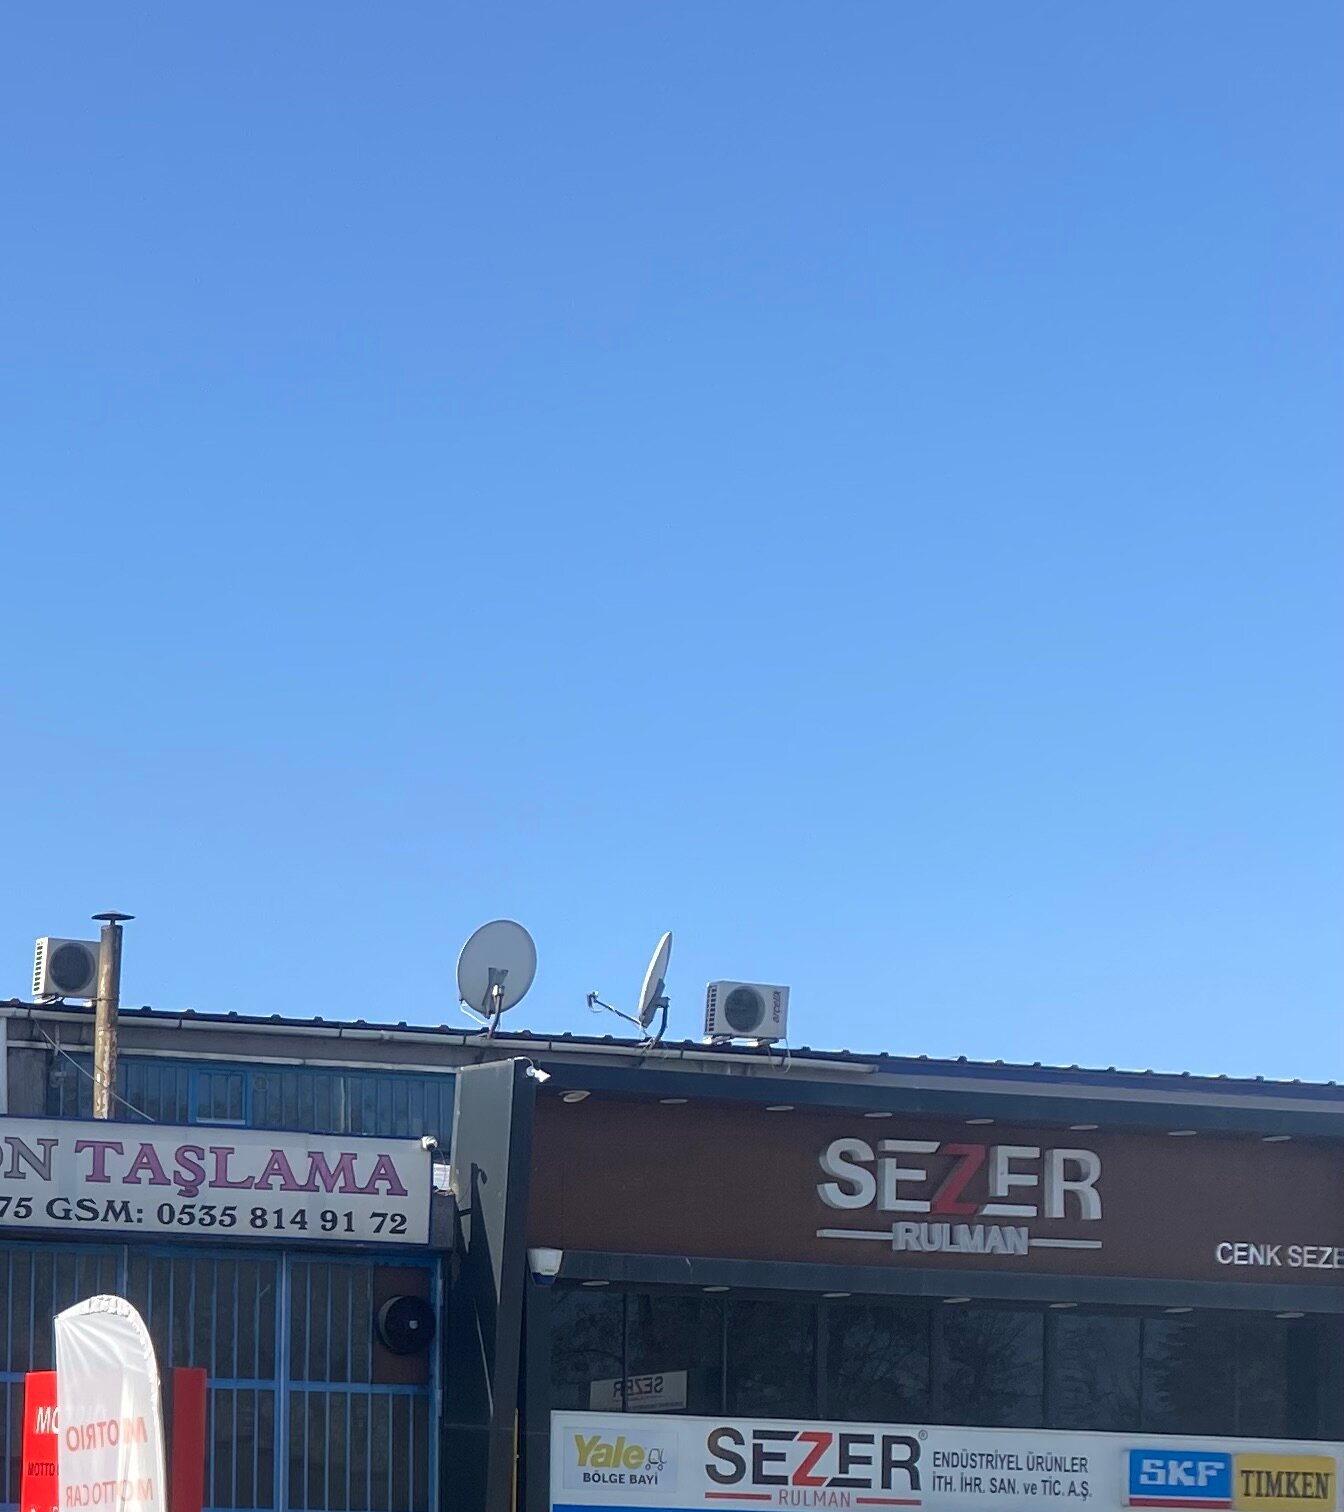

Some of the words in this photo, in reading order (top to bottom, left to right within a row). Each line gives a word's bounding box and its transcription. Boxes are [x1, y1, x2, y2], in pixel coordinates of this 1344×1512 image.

[75, 1139, 408, 1198] TAŞLAMA
[816, 1138, 1102, 1220] SEZER
[46, 1197, 144, 1224] GSM:
[157, 1202, 237, 1228] 0535
[249, 1206, 308, 1230] 814
[320, 1209, 355, 1233] 91
[368, 1212, 407, 1235] 72
[892, 1221, 1029, 1255] RULMAN
[1216, 1242, 1282, 1266] CENK
[574, 1434, 645, 1469] Yale
[705, 1427, 922, 1491] SEZER
[932, 1449, 1023, 1470] ENDÜSTRİYEL
[1026, 1451, 1089, 1473] ÜRÜNLER
[583, 1470, 625, 1484] BÖLGE
[629, 1472, 658, 1485] BAYİ
[932, 1471, 957, 1492] İTH.
[960, 1472, 986, 1494] İHR.
[989, 1477, 1020, 1495] SAN.
[1023, 1483, 1038, 1495] ve
[1041, 1476, 1065, 1496] TİC.
[1068, 1480, 1093, 1501] A.Ş.
[1139, 1459, 1225, 1487] SKF
[1240, 1470, 1333, 1499] TIMKEN
[778, 1489, 851, 1507] RULMAN
